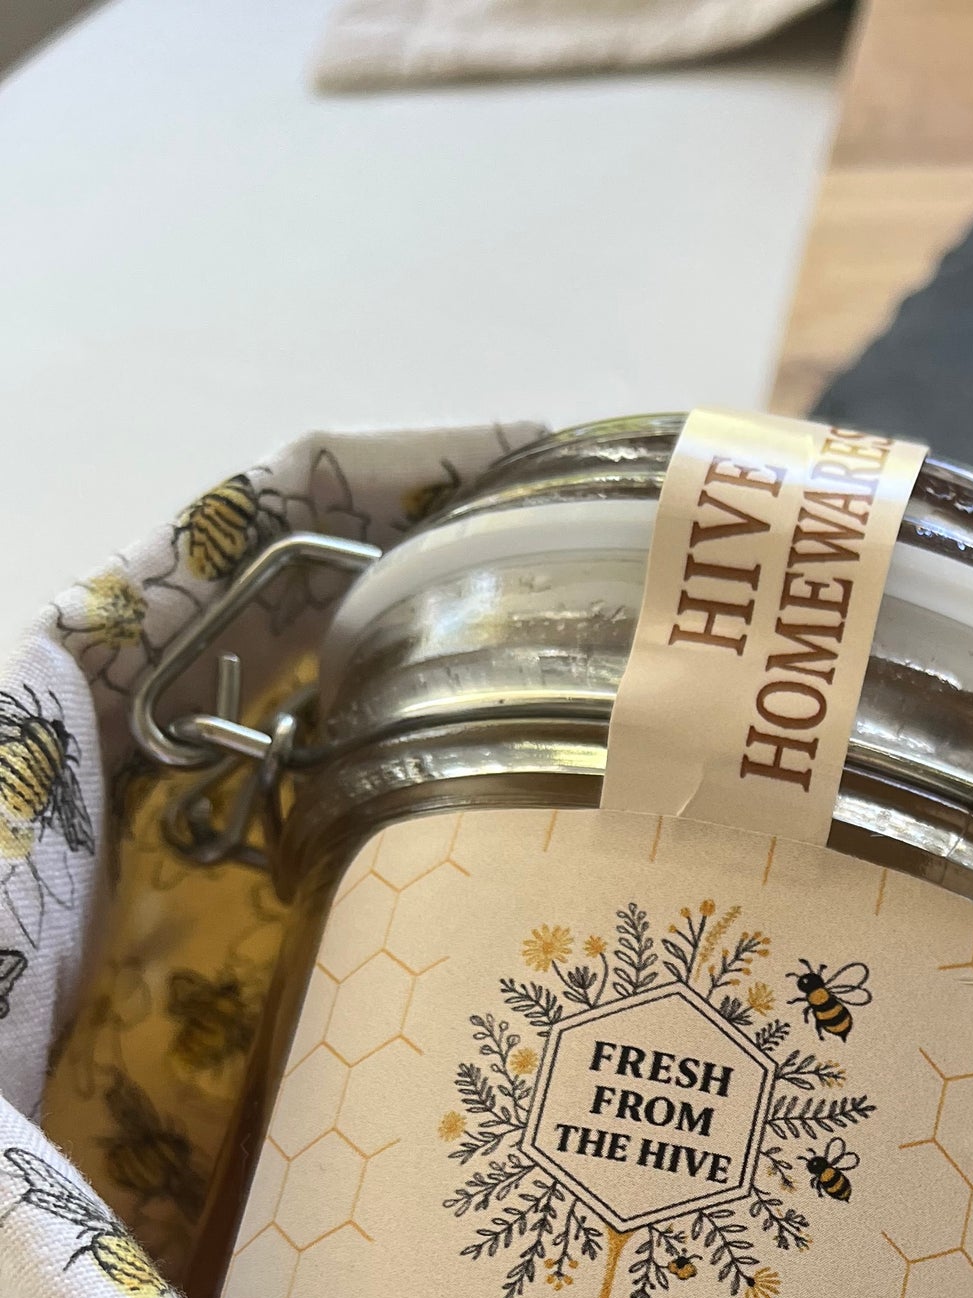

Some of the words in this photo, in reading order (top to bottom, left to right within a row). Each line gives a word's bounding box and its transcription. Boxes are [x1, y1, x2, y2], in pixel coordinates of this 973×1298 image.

[667, 455, 788, 657] HIVE
[589, 1040, 734, 1097] FRESH
[589, 1085, 715, 1137] FROM
[554, 1123, 632, 1163] THE
[636, 1138, 732, 1184] HIVE
